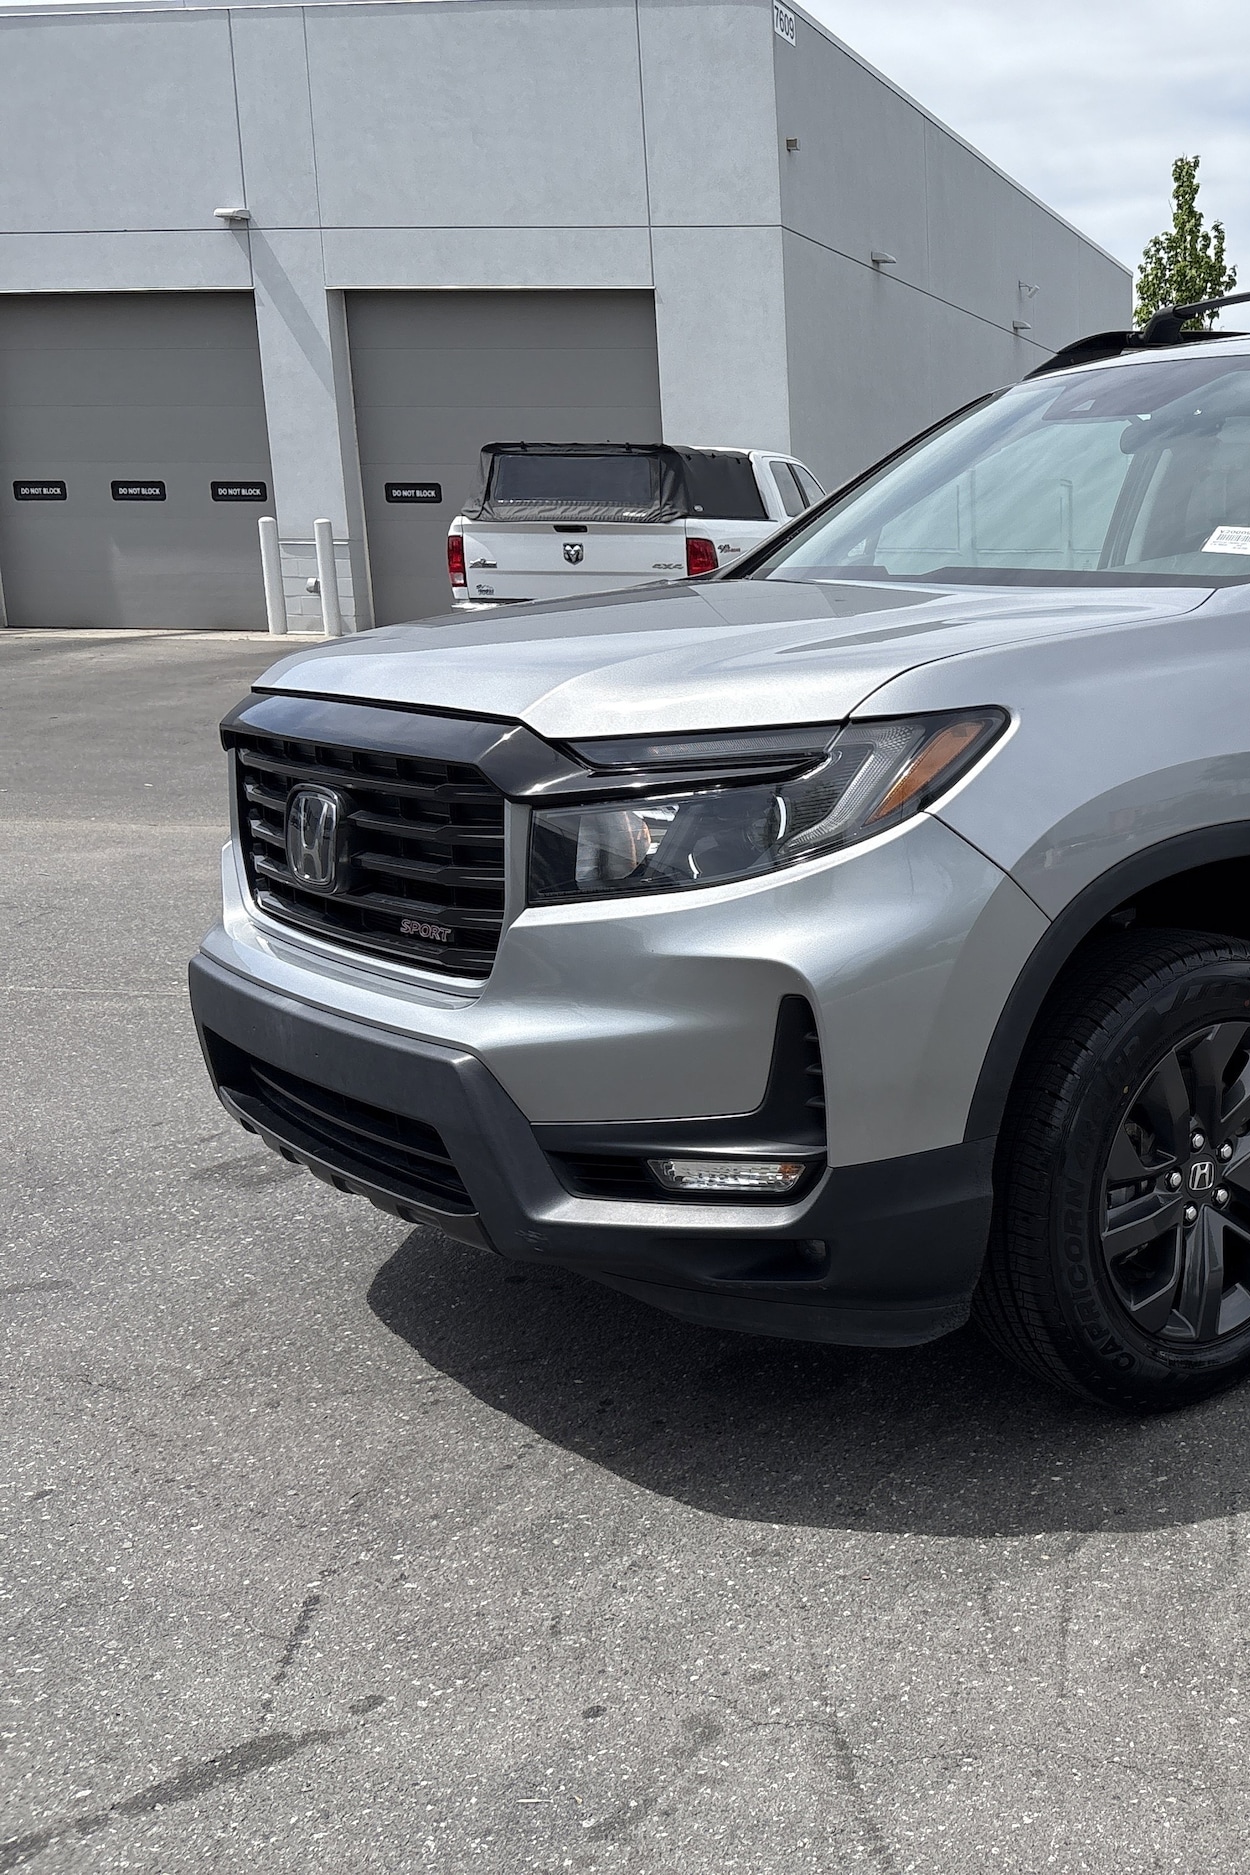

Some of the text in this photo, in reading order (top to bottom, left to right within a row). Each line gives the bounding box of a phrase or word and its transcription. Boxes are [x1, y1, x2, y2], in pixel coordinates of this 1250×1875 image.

[775, 5, 794, 40] 7609
[21, 487, 61, 495] DO NOT BLOCK
[119, 487, 161, 495] DO NOT BLOCK
[218, 488, 261, 496] DO NOT BLOCK
[392, 489, 436, 497] DO NOT BLOCK
[400, 919, 452, 942] SPORT
[1062, 1177, 1136, 1372] CAPRICORN
